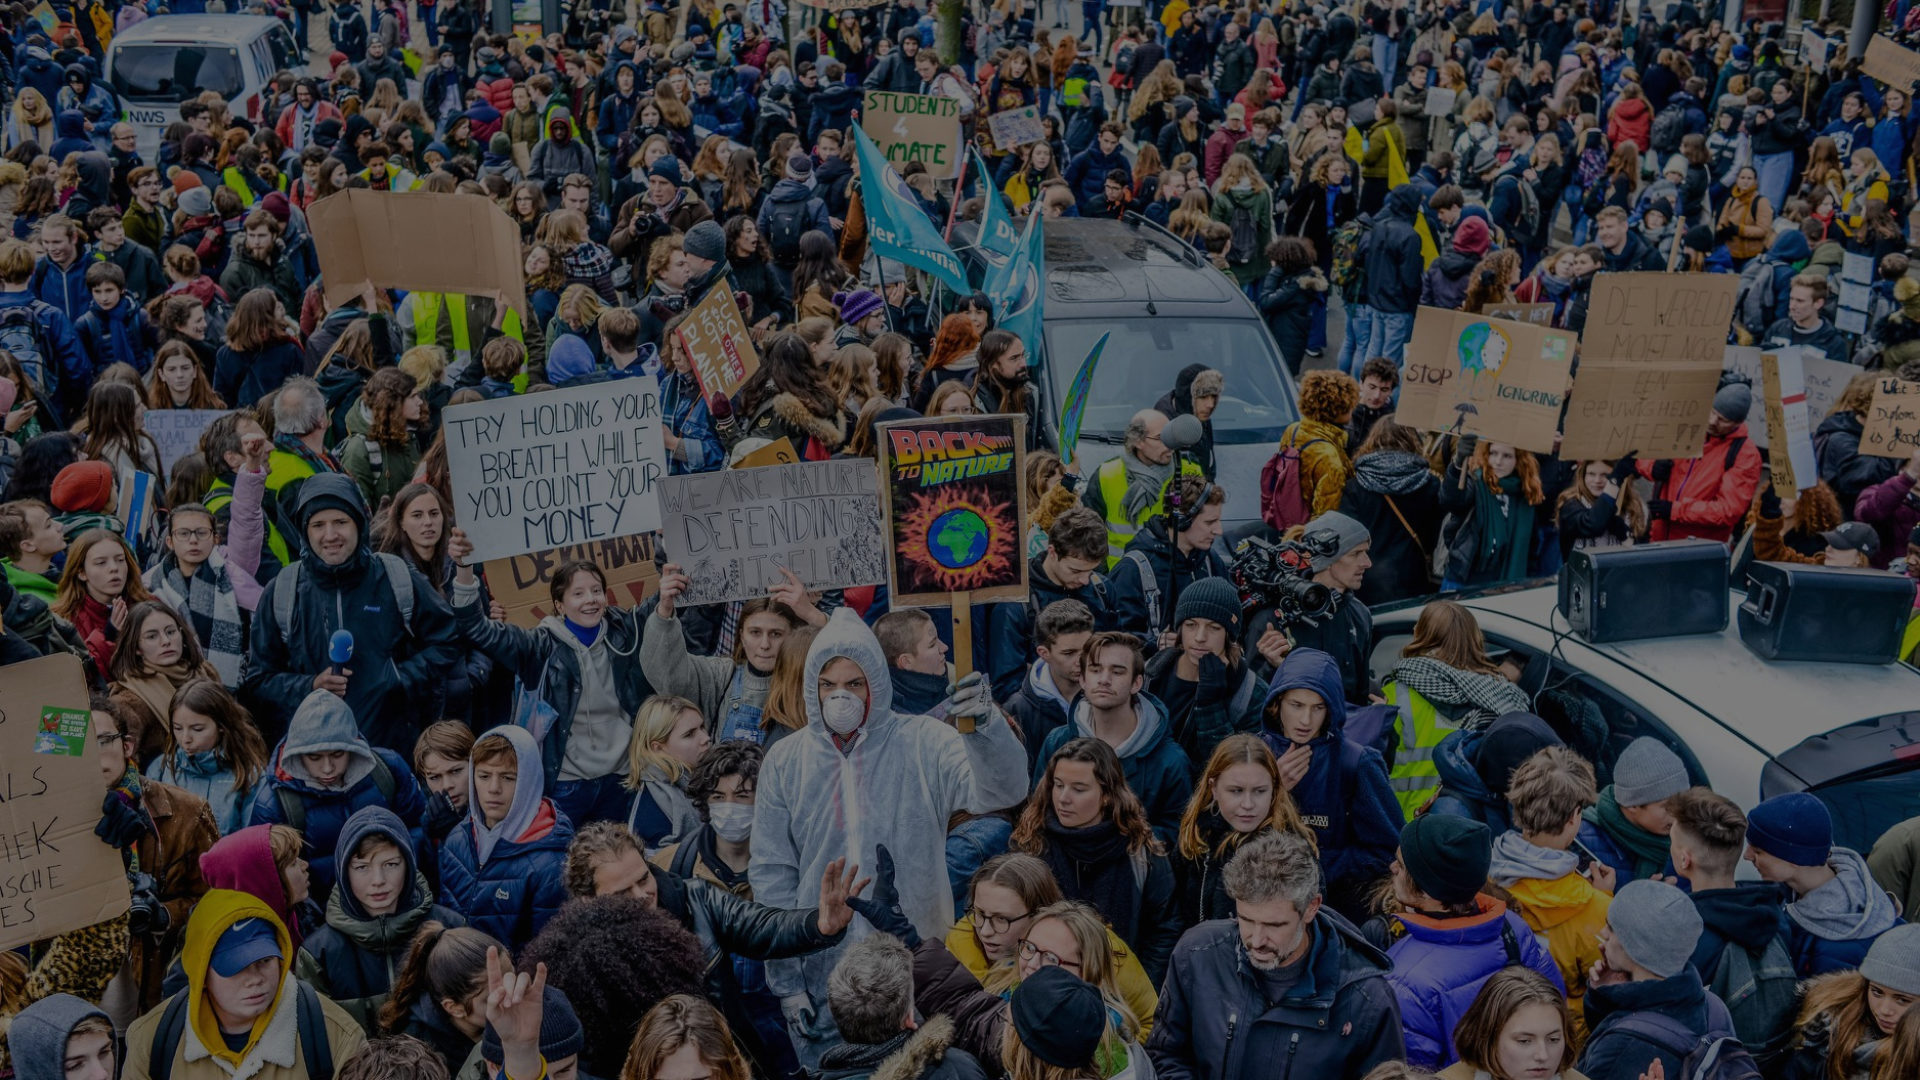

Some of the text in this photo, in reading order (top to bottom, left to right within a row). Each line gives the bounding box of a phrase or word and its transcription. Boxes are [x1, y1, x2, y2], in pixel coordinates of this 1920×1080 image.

[129, 111, 165, 123] NWS
[868, 92, 960, 117] STUDENTS
[892, 116, 909, 137] 4
[870, 138, 946, 165] IMATE
[714, 290, 745, 348] FUCK
[1604, 286, 1649, 326] DE
[699, 309, 737, 387] NOT THE
[724, 339, 744, 378] OTHER
[1610, 334, 1673, 362] MOET
[1406, 364, 1453, 386] STOP
[1497, 384, 1562, 408] IGNORING
[448, 393, 658, 448] TRY HOLDING YOUR
[480, 427, 652, 485] BREATH WHILE
[888, 429, 993, 466] BACK
[658, 461, 877, 514] WE ARE NATURE
[898, 451, 1014, 488] TO NATURE
[468, 462, 661, 521] YOU COUNT YOUR
[524, 500, 626, 549] MONEY
[682, 499, 855, 556] DEFENDING
[738, 546, 841, 596] ITSELF
